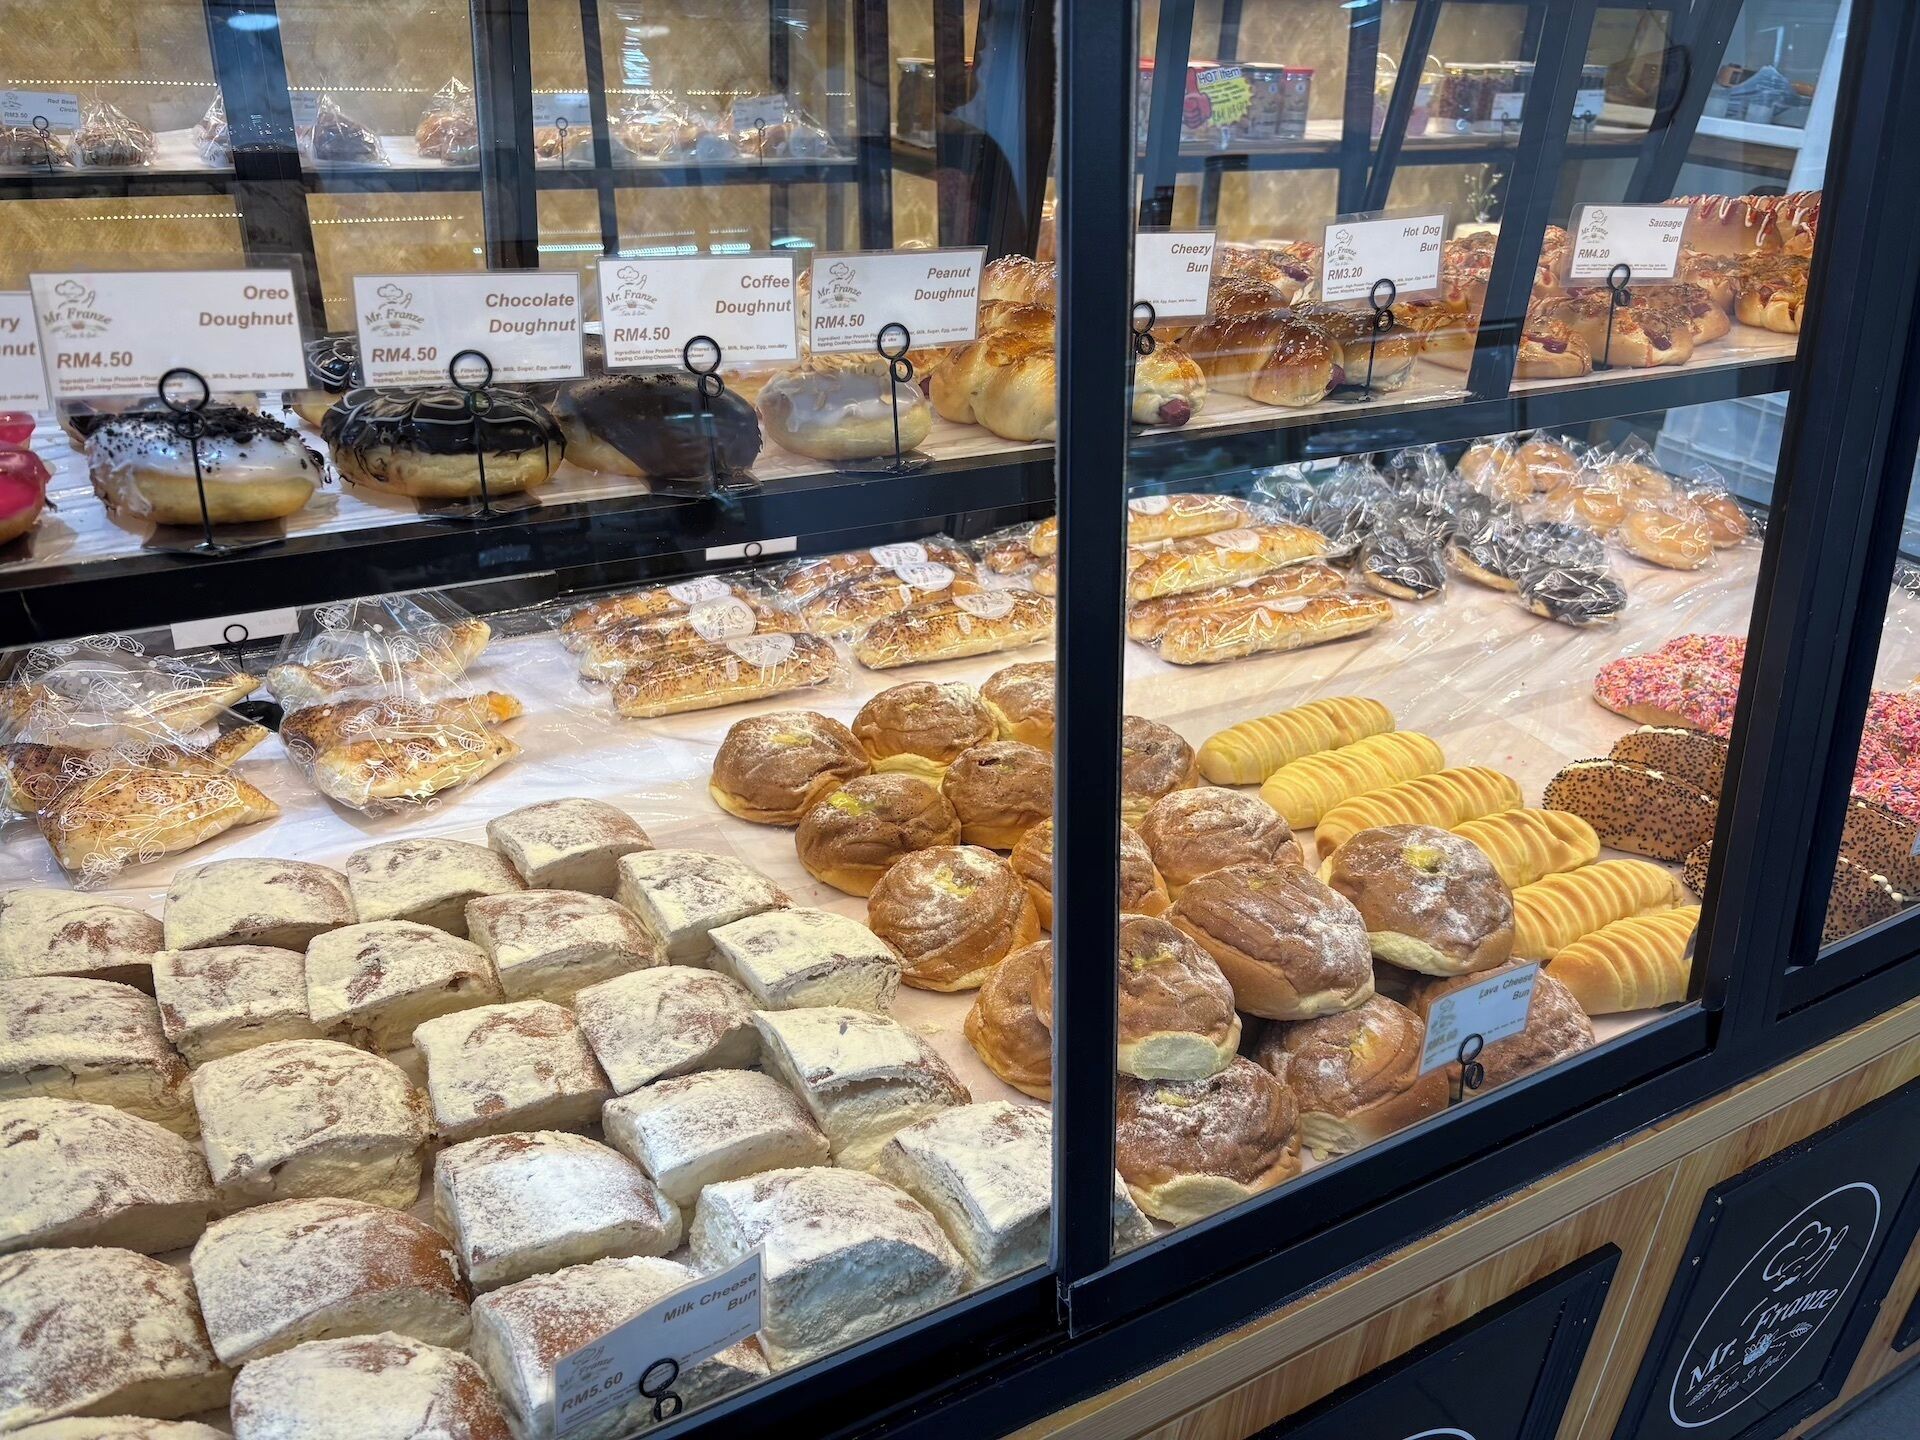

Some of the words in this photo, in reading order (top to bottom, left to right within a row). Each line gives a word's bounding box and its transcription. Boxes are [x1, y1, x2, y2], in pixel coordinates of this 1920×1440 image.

[1403, 227, 1418, 237] Hot
[1422, 225, 1441, 236] Dog
[1648, 218, 1682, 229] Sausage
[1662, 234, 1679, 243] Bun
[1171, 244, 1212, 256] Cheezy
[1420, 243, 1438, 252] Bun
[1578, 249, 1610, 259] RM4.20
[927, 267, 971, 280] Peanut
[1186, 262, 1209, 272] Bun
[1327, 266, 1363, 281] RM3.20
[741, 274, 790, 289] Coffee
[243, 286, 289, 300] Oreo
[606, 292, 621, 305] Mr.
[624, 289, 658, 304] Franze
[817, 288, 831, 299] Mr.
[833, 283, 863, 297] Franze
[914, 287, 975, 303] Doughnut
[486, 292, 575, 308] Chocolate
[715, 299, 792, 316] Doughnut
[43, 310, 63, 327] Mr.
[66, 307, 113, 325] Franze
[199, 311, 294, 329] Doughnut
[365, 311, 382, 326] Mr.
[386, 308, 425, 323] Franze
[815, 313, 865, 329] RM4.50
[489, 318, 576, 335] Doughnut
[613, 327, 671, 342] RM4.50
[57, 352, 133, 369] RM4.50
[371, 347, 437, 363] RM4.50
[1478, 985, 1499, 999] Lava
[1502, 973, 1533, 989] Cheese
[1512, 989, 1530, 1000] Bun
[663, 1302, 695, 1323] Milk
[700, 1272, 757, 1306] Cheese
[727, 1289, 757, 1312] Bun
[1685, 1338, 1737, 1395] Mr.
[1745, 1288, 1838, 1344] Franze
[561, 1371, 623, 1413] RM5.60
